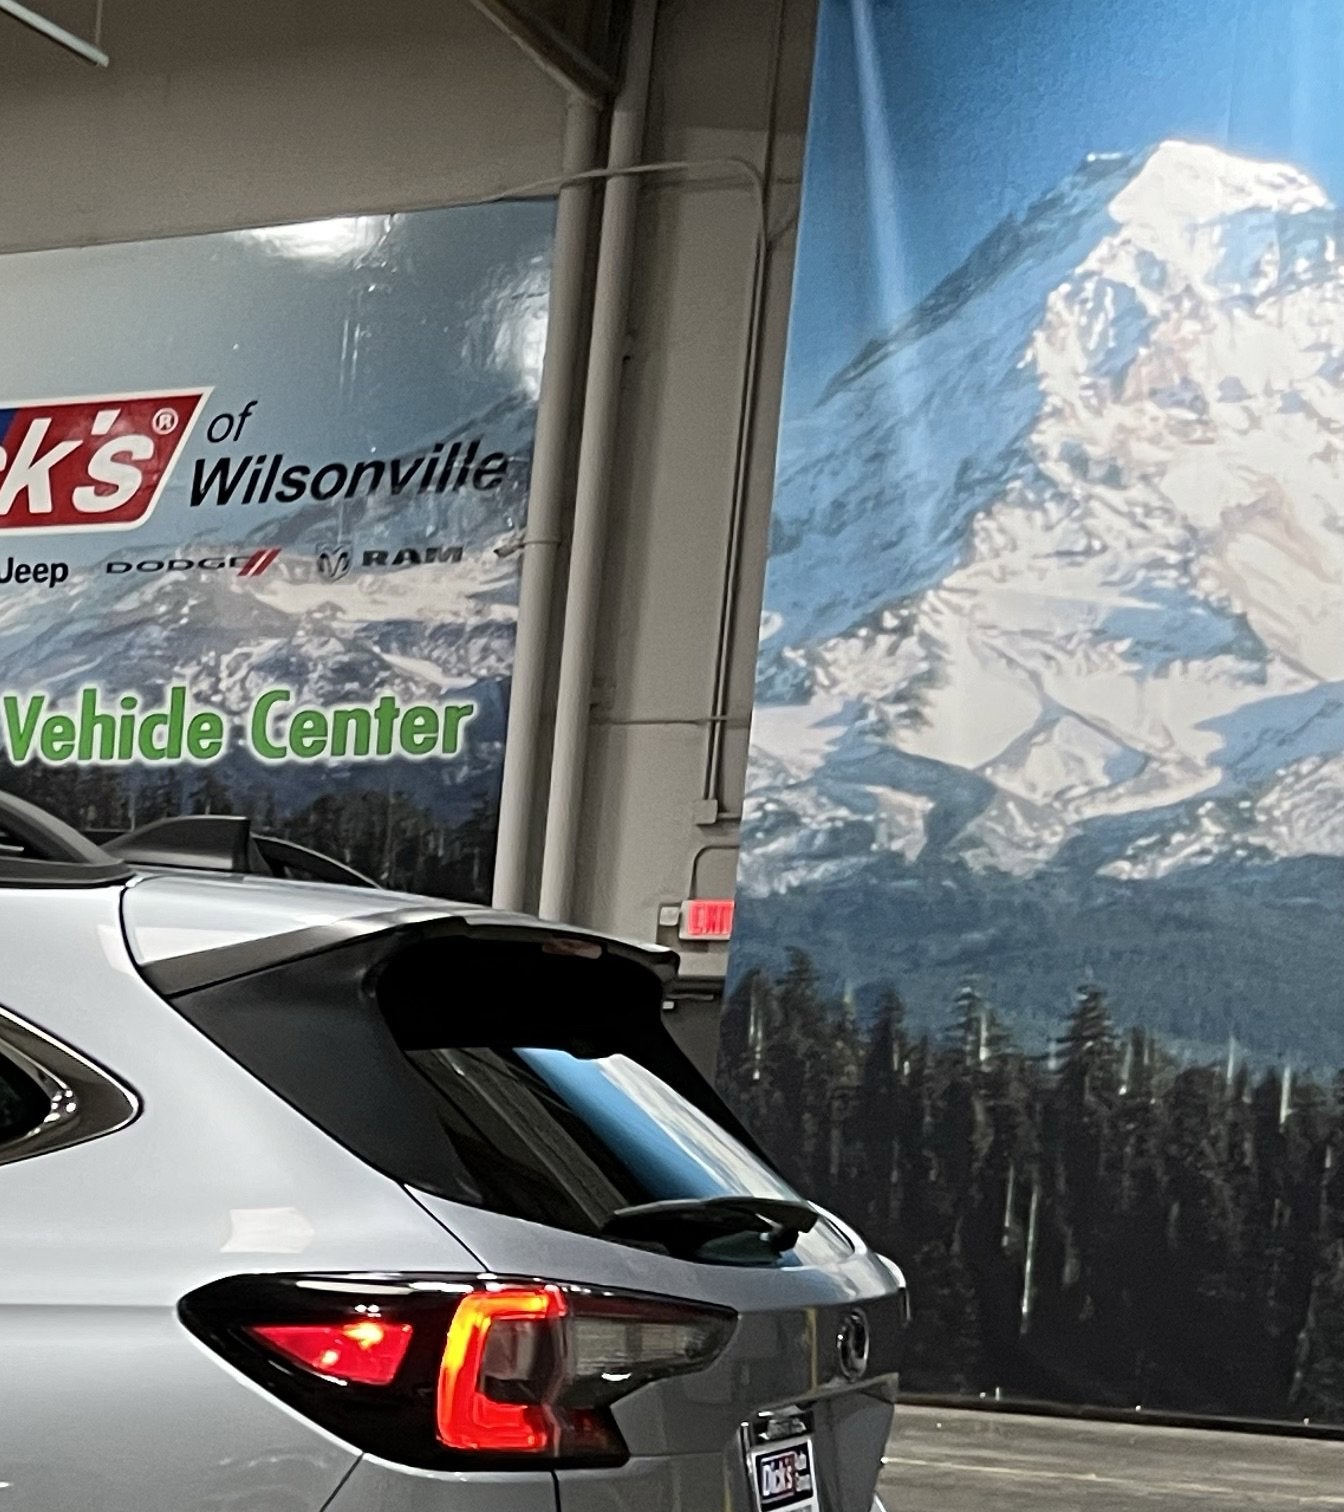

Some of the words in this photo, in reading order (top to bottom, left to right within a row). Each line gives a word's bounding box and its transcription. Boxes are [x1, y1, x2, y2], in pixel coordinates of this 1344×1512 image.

[207, 401, 258, 444] of
[190, 441, 508, 508] Wilsonville
[362, 546, 464, 568] RAM
[4, 687, 223, 764] Vehicle
[252, 691, 474, 756] Center
